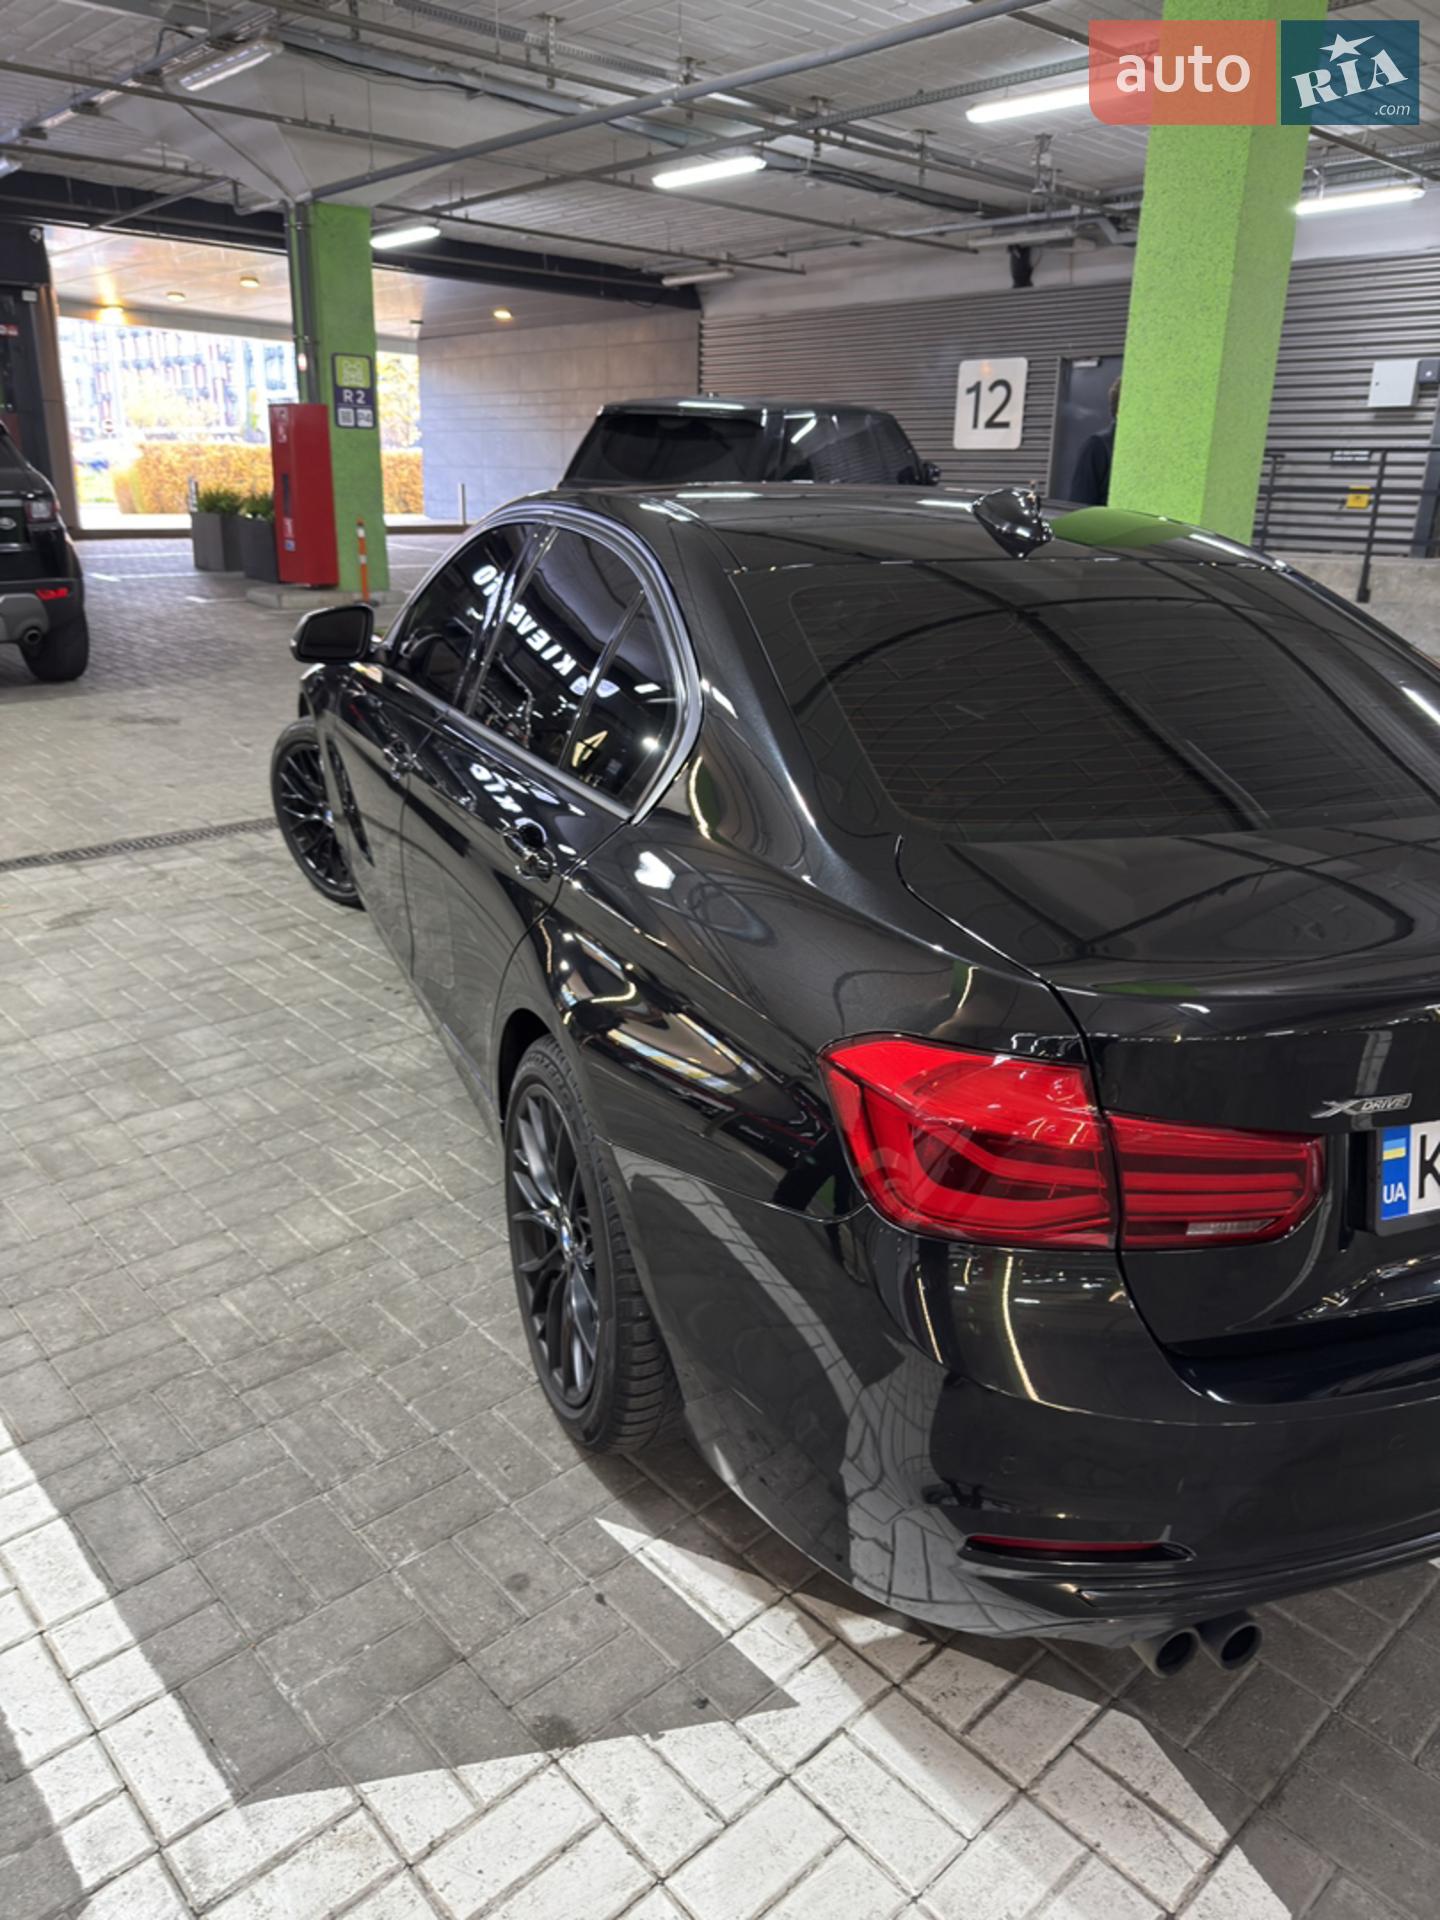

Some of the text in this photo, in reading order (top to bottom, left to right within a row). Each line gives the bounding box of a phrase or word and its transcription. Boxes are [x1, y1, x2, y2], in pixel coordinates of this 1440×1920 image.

[965, 379, 1012, 430] 12
[1418, 1134, 1440, 1199] K
[1383, 1182, 1406, 1204] UA
